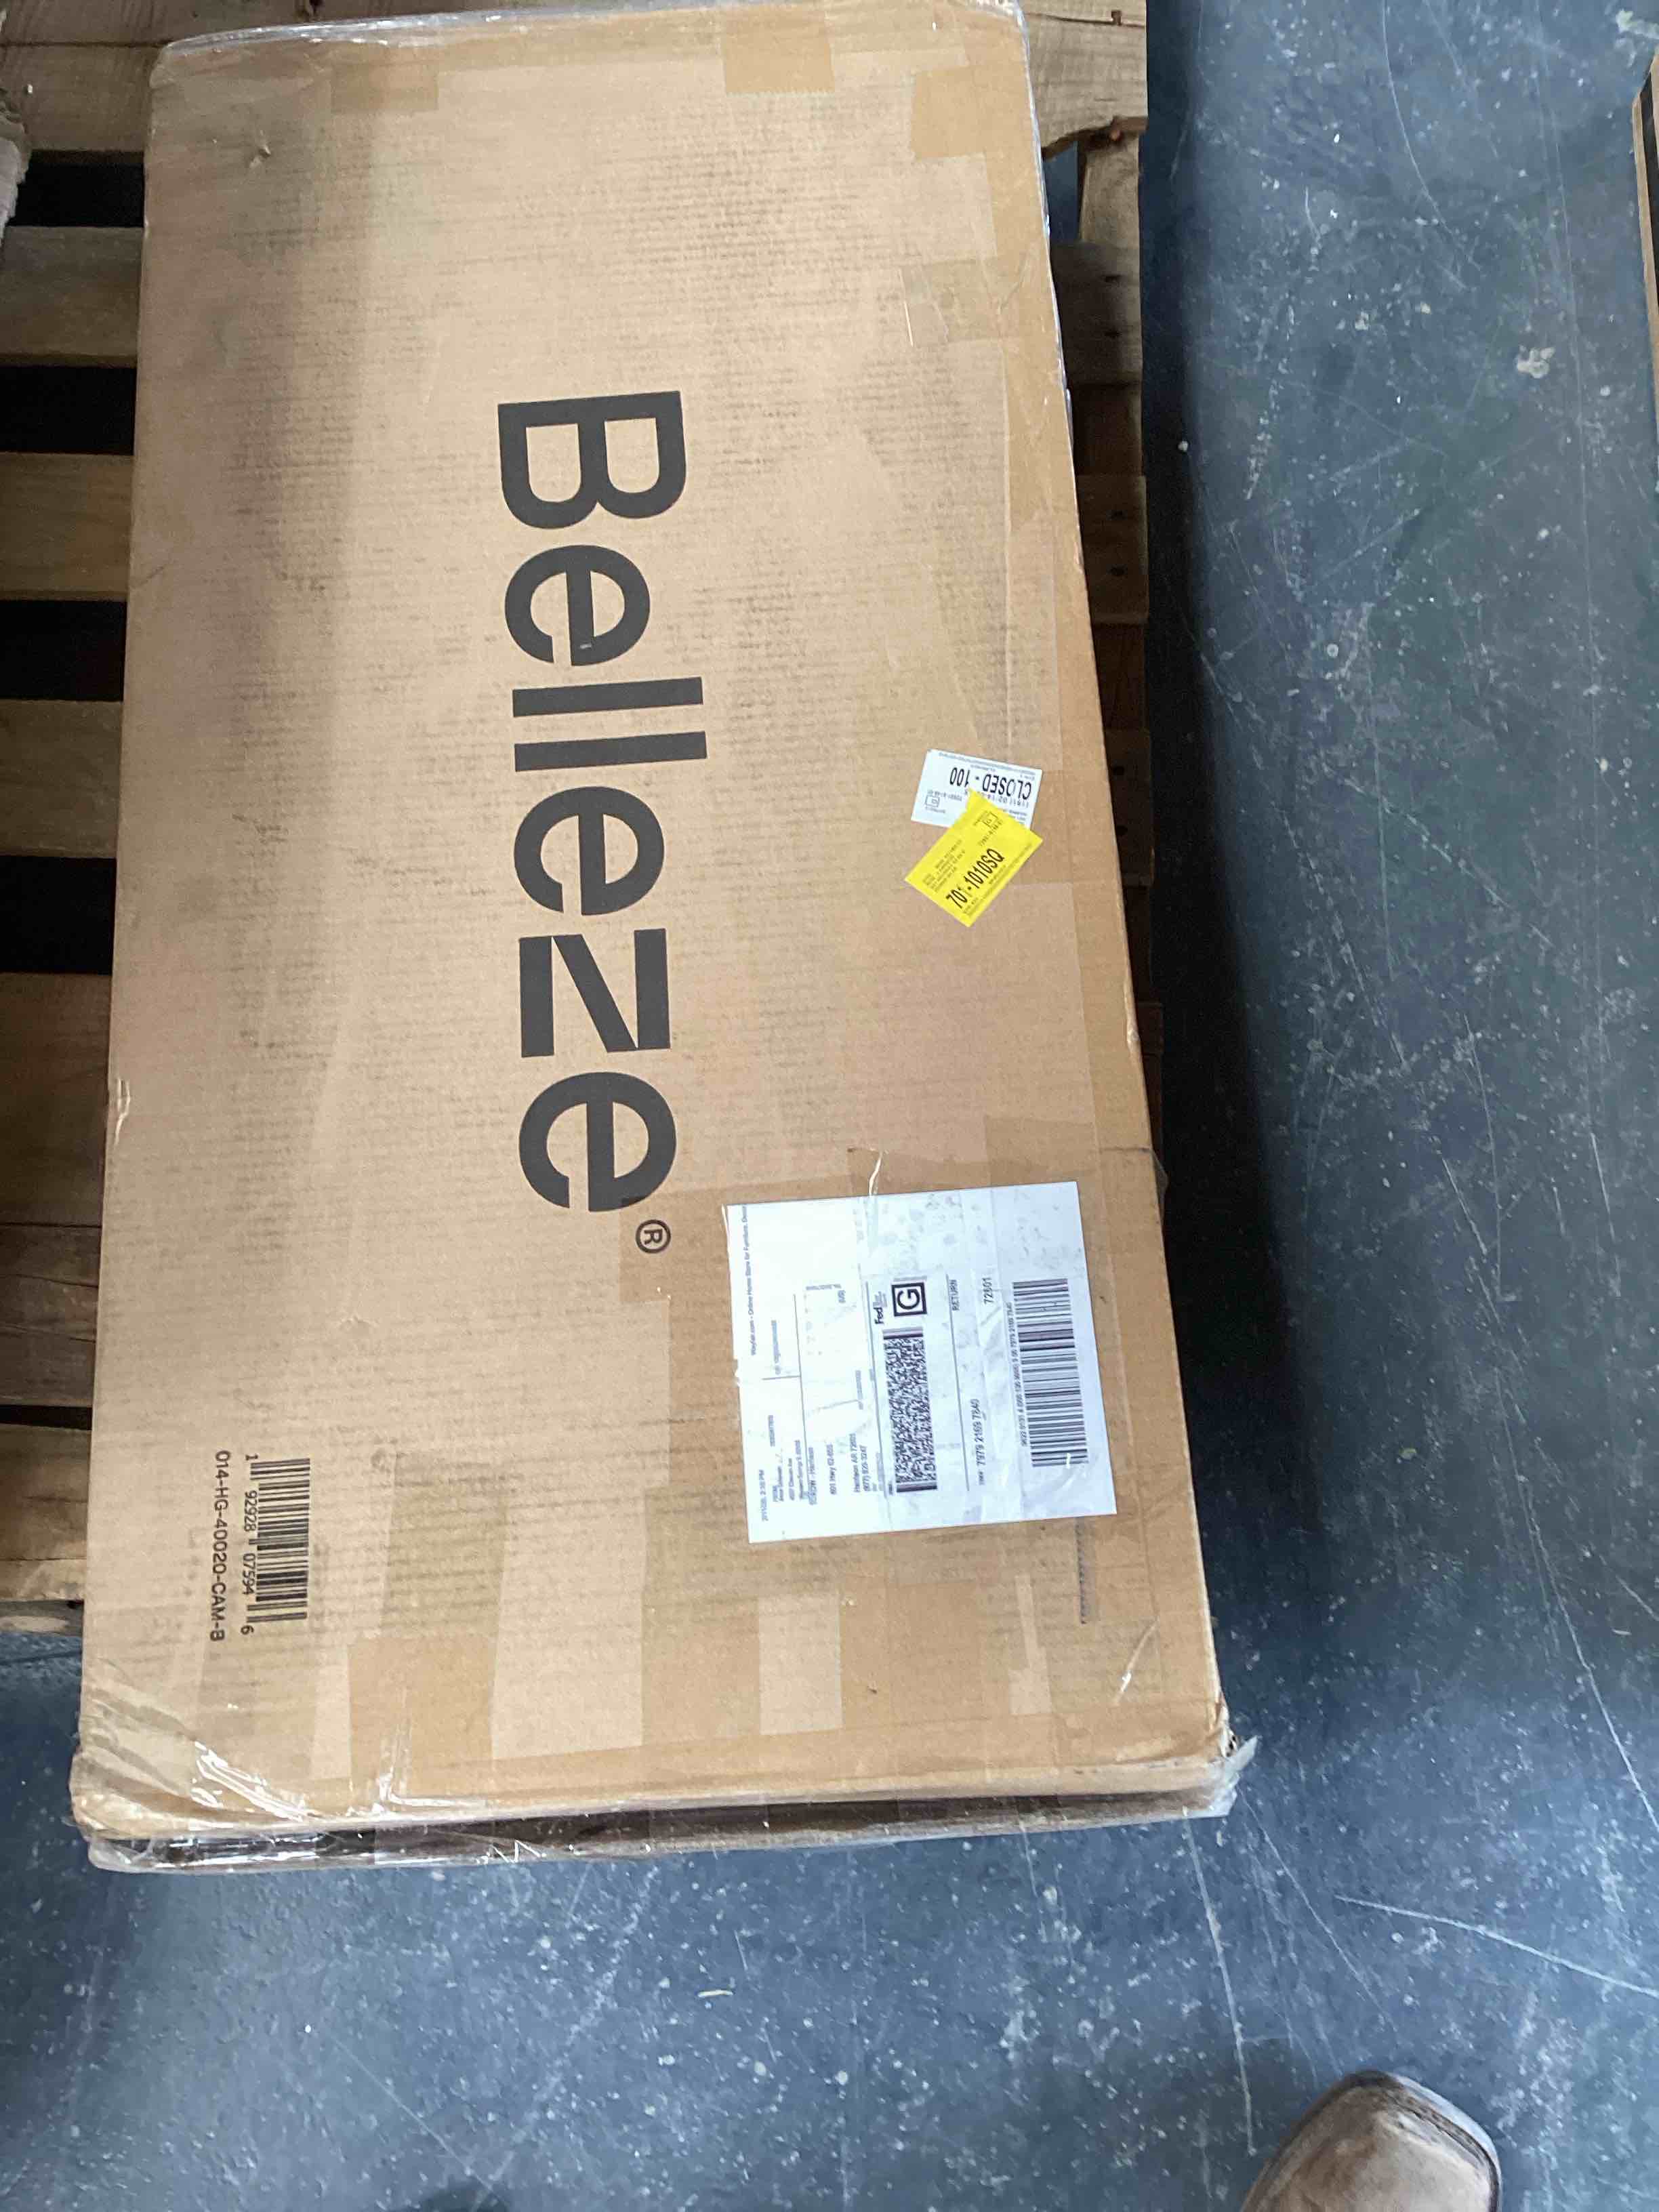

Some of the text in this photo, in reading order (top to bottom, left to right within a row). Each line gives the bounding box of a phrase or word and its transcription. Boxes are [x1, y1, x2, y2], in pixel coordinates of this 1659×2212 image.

[949, 767, 970, 786] 100
[982, 773, 1031, 801] CLOSED
[498, 390, 707, 1212] Belleze
[896, 1289, 922, 1311] G
[951, 1279, 960, 1311] RETURN
[241, 1454, 258, 1635] 1 92928 07594 6
